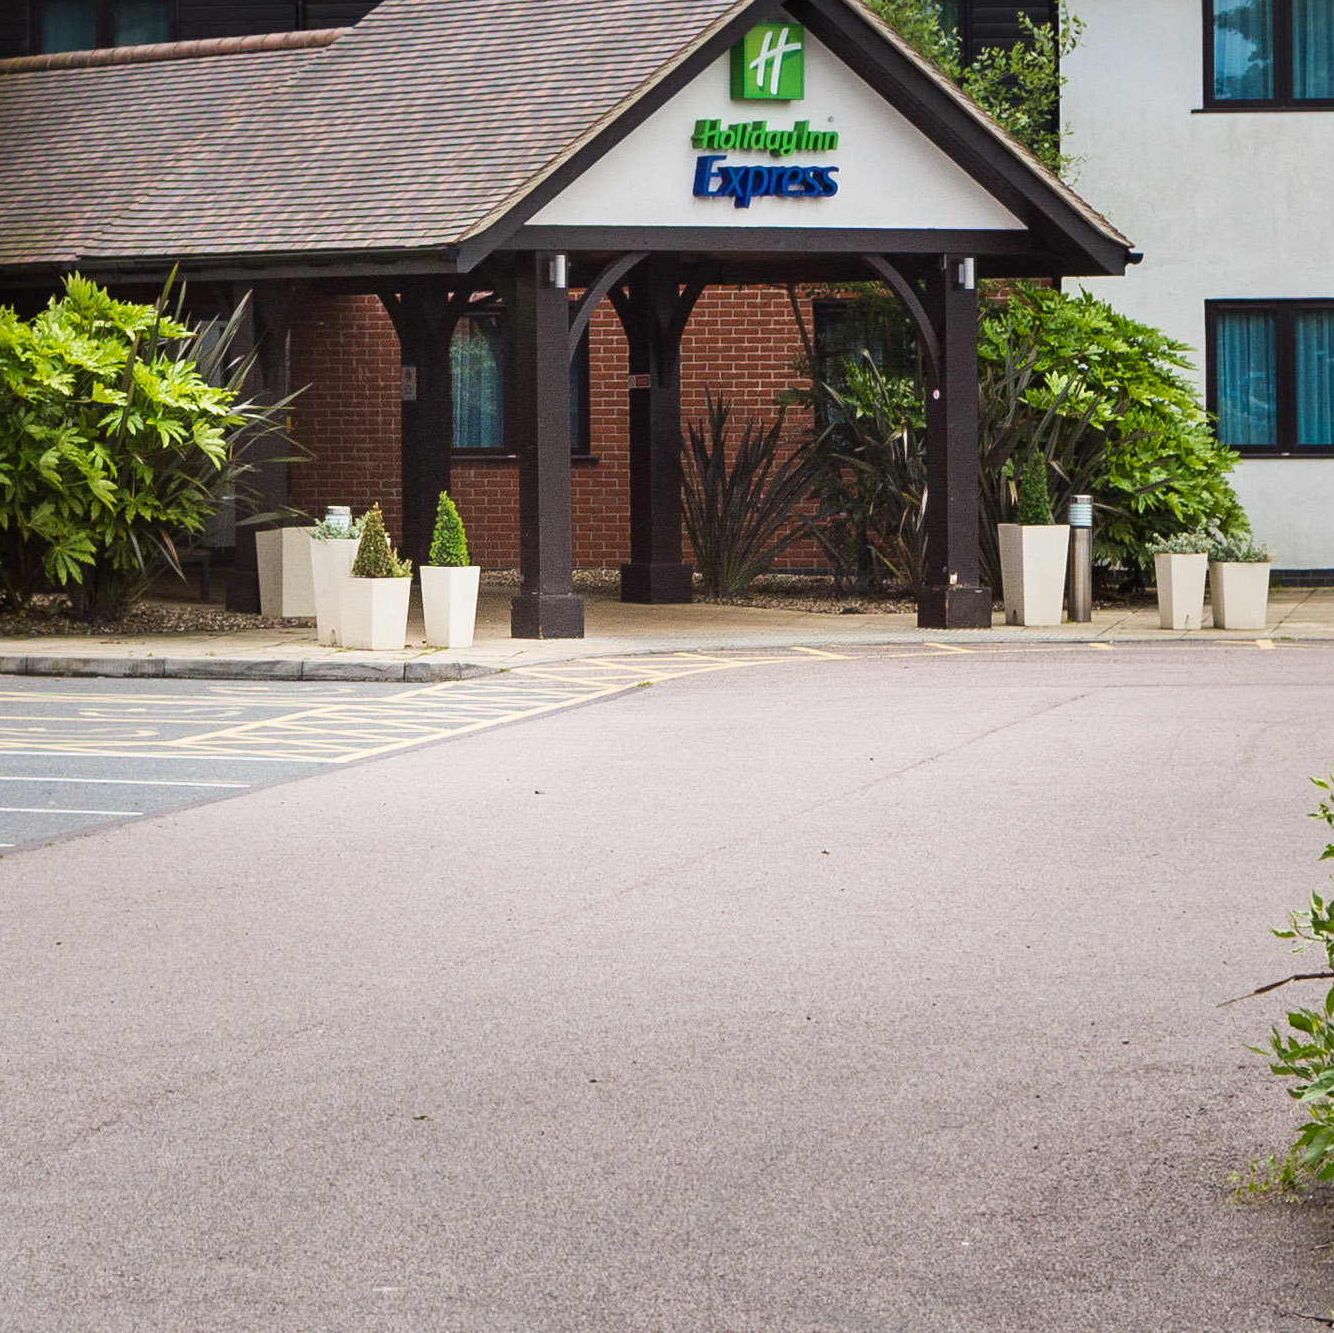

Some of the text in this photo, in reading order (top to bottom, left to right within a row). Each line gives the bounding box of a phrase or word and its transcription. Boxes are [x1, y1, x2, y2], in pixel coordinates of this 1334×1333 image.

[749, 27, 802, 95] H
[692, 119, 839, 157] Holiday Inn
[692, 155, 840, 208] Express
